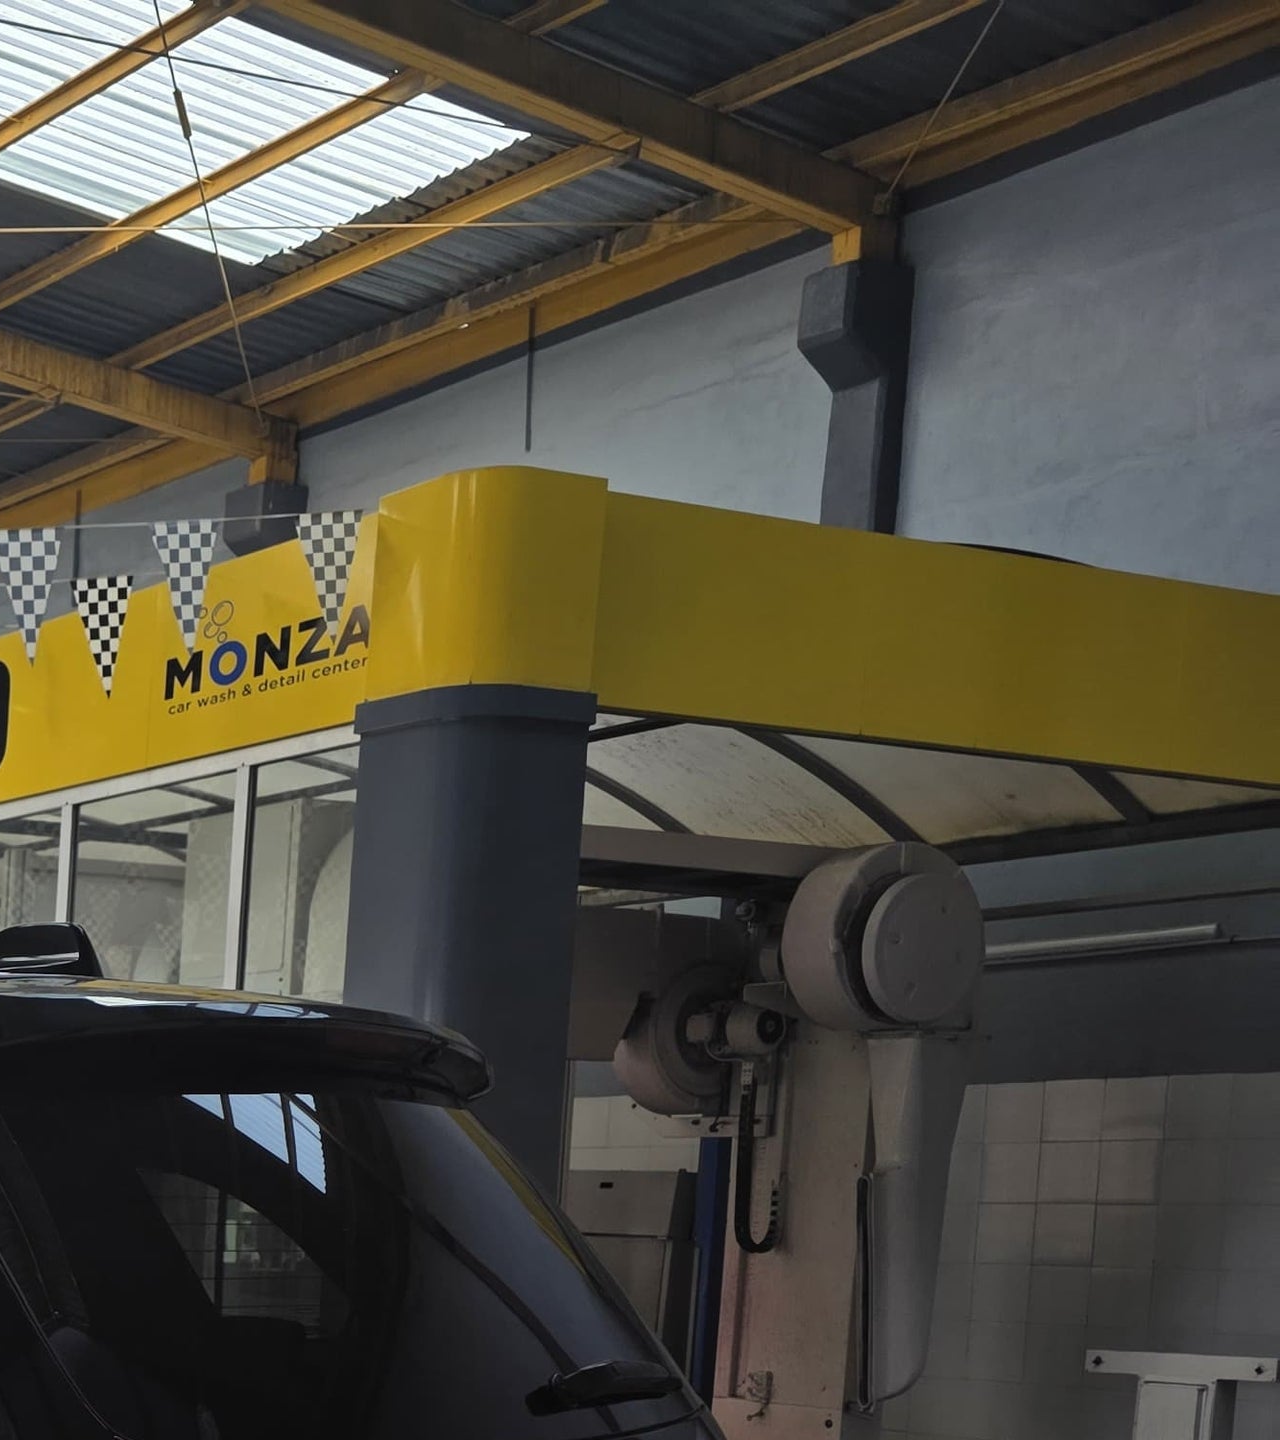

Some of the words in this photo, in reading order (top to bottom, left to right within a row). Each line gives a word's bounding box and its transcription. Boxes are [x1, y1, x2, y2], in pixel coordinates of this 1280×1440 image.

[164, 603, 371, 701] MONZA
[168, 700, 191, 715] car
[197, 687, 236, 708] wash
[241, 684, 252, 697] &
[258, 669, 306, 693] detail
[312, 656, 369, 680] center
